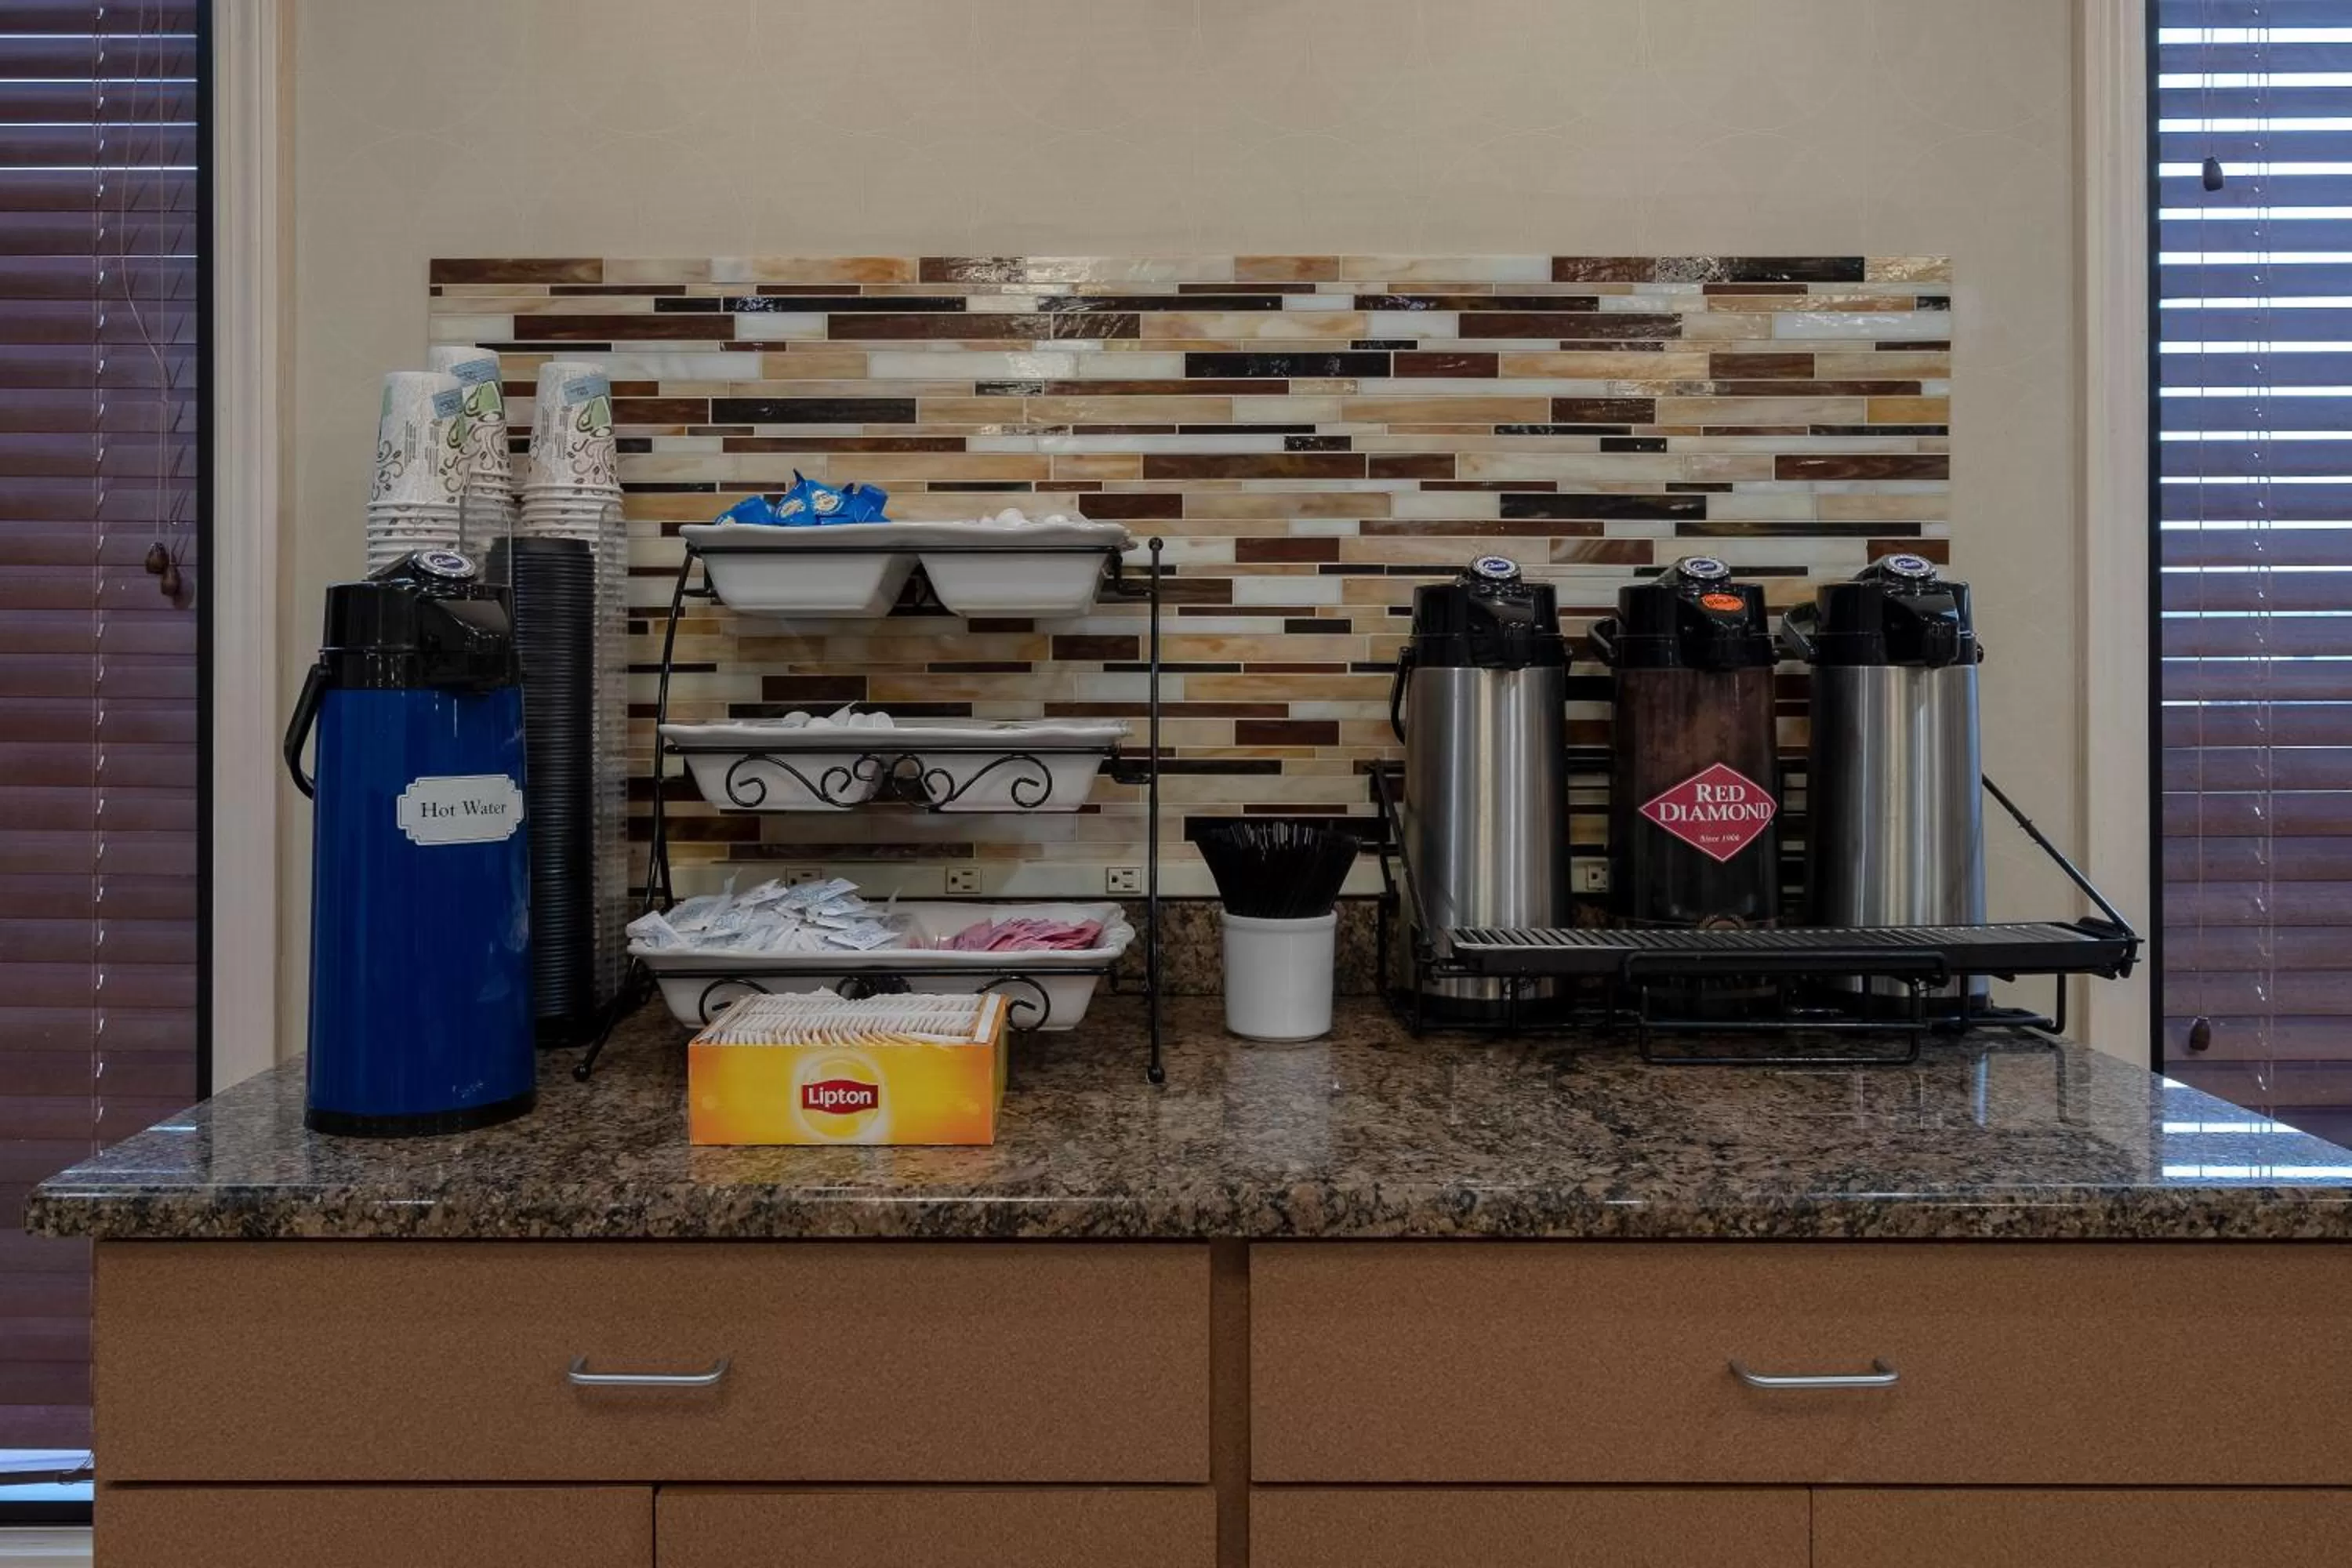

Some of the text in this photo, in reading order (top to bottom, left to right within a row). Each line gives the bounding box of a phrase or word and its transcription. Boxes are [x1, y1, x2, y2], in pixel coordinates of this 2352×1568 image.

[1695, 783, 1746, 803] RED
[420, 799, 507, 818] Hot Water
[1658, 801, 1772, 822] DIAMOND
[808, 1087, 872, 1108] Lipton
